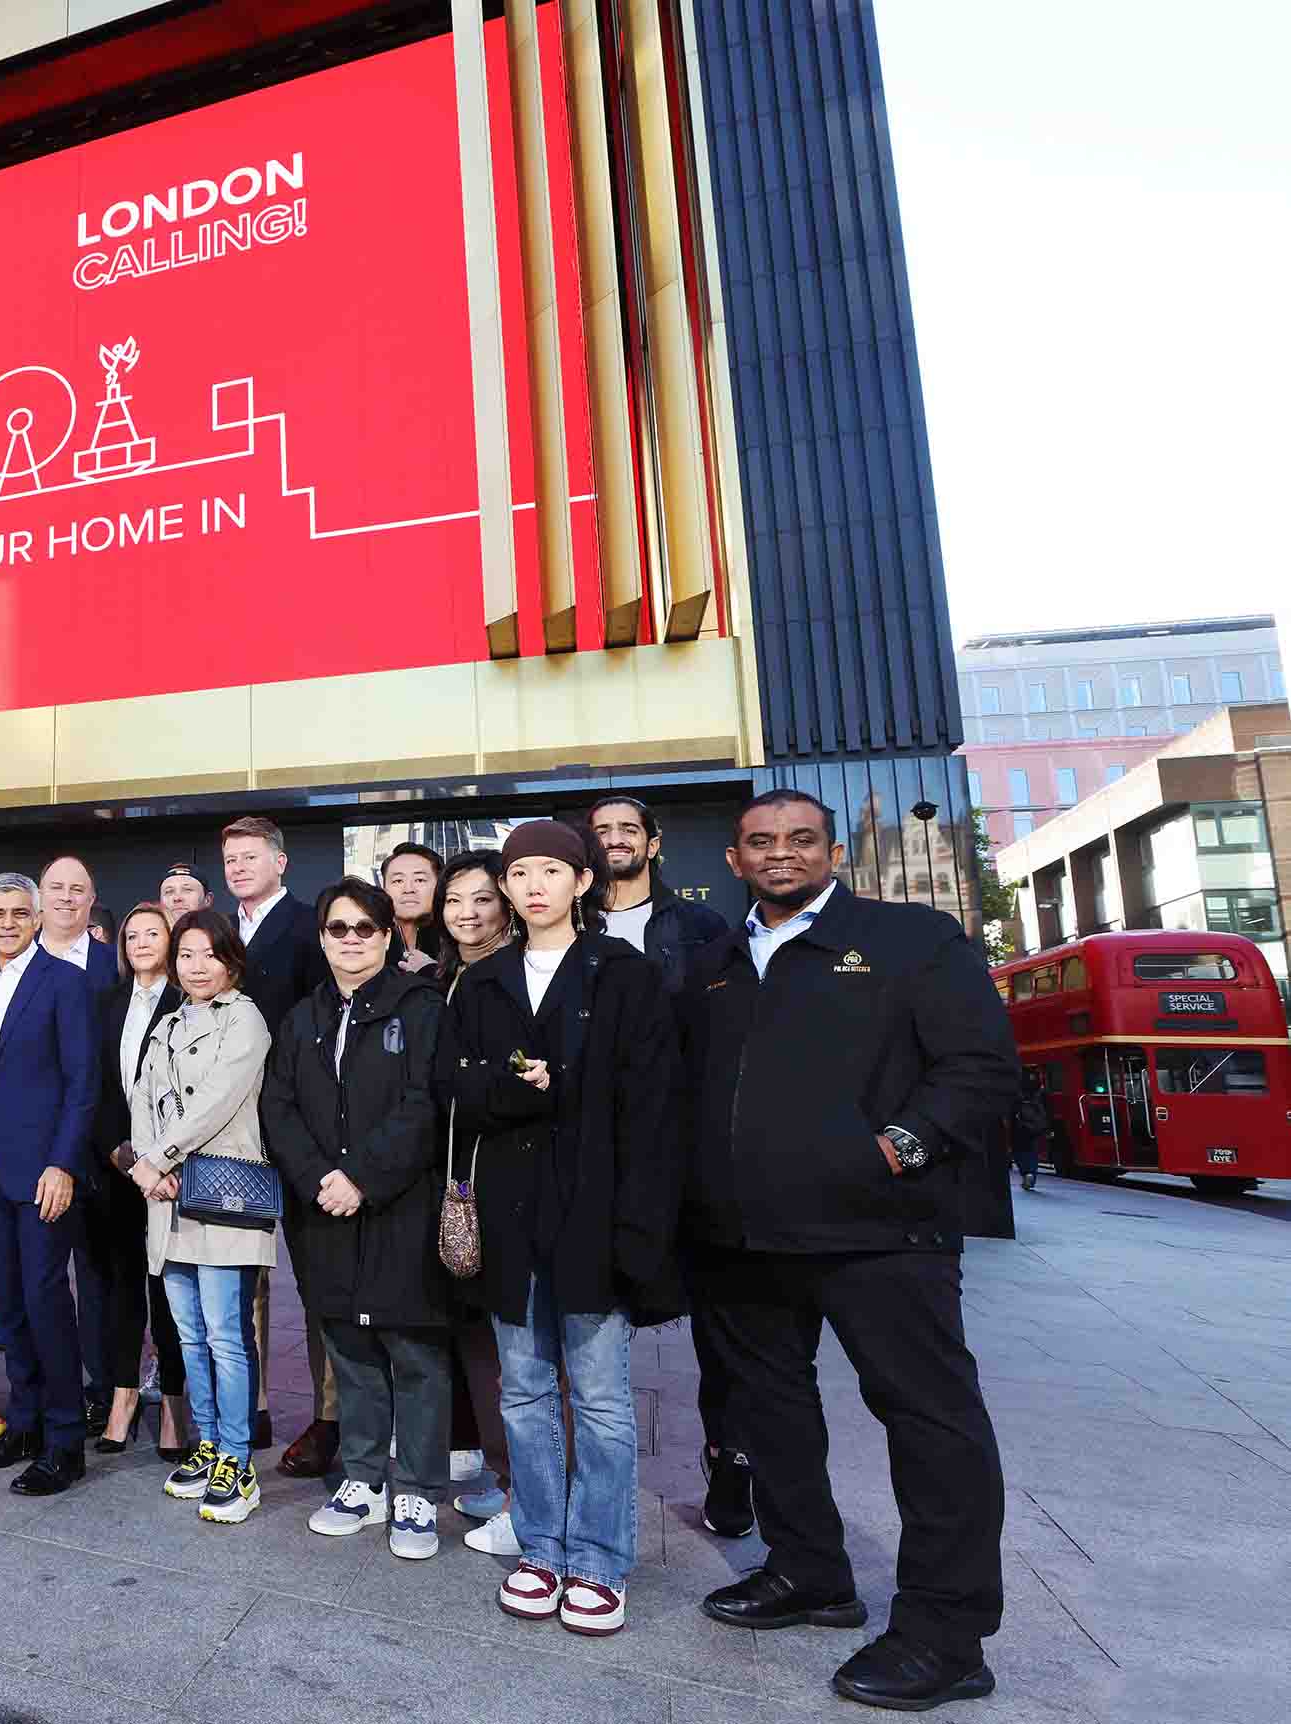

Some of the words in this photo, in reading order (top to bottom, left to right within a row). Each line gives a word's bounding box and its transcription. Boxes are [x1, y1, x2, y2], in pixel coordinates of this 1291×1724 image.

[77, 152, 303, 247] LONDON
[73, 198, 308, 290] CALLING!
[48, 503, 184, 559] HOME
[201, 493, 246, 535] IN
[1168, 994, 1215, 1003] SPECIAL
[1169, 1003, 1215, 1011] SERVICE
